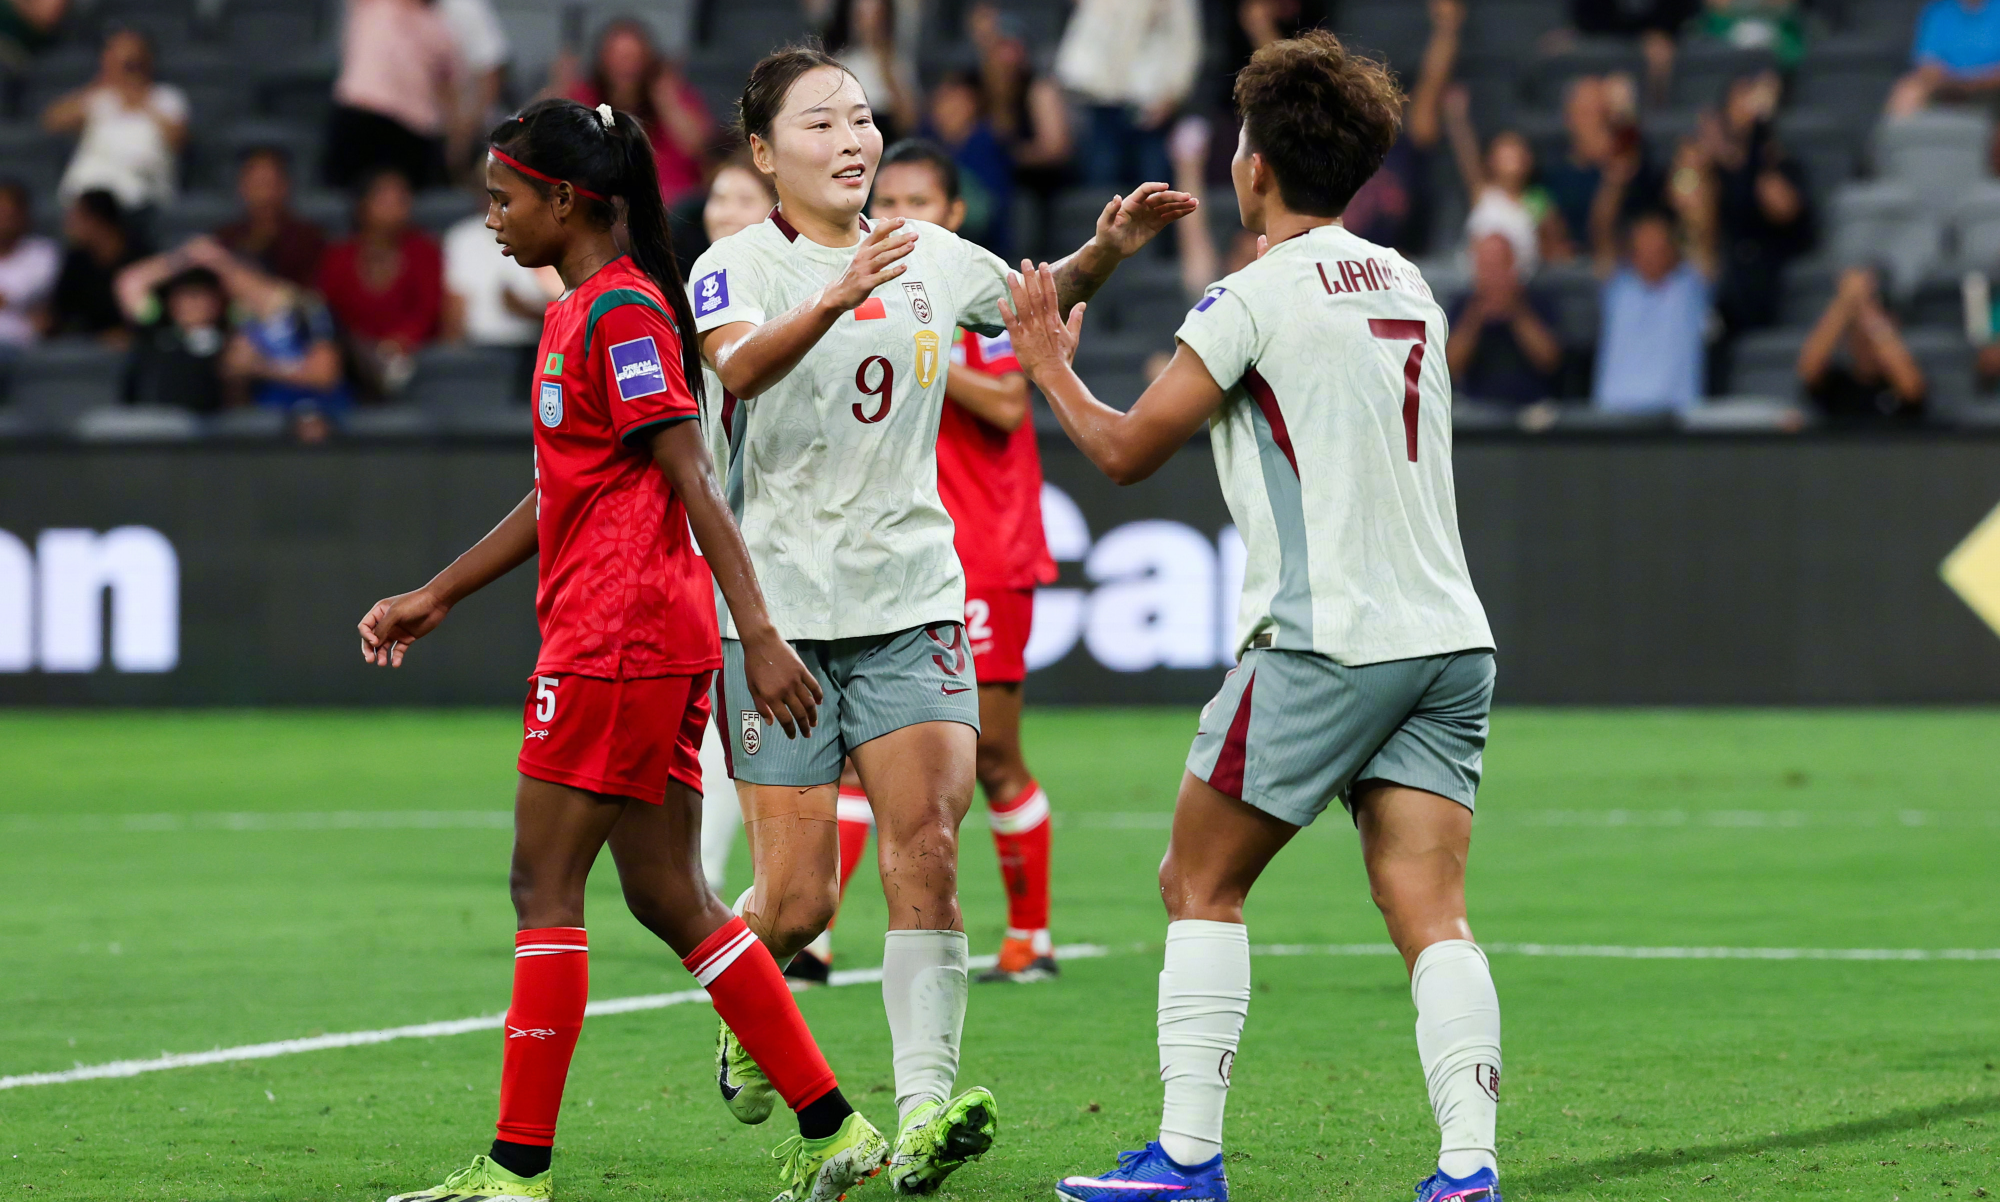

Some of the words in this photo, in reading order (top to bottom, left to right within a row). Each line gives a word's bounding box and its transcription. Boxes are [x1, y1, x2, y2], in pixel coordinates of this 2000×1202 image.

[904, 284, 924, 293] CFA
[1316, 257, 1403, 295] WANG
[621, 359, 652, 374] DREAM
[852, 355, 894, 424] 9
[1367, 318, 1427, 463] 7
[925, 624, 966, 676] 9
[536, 676, 559, 722] 5
[743, 713, 760, 722] CFA
